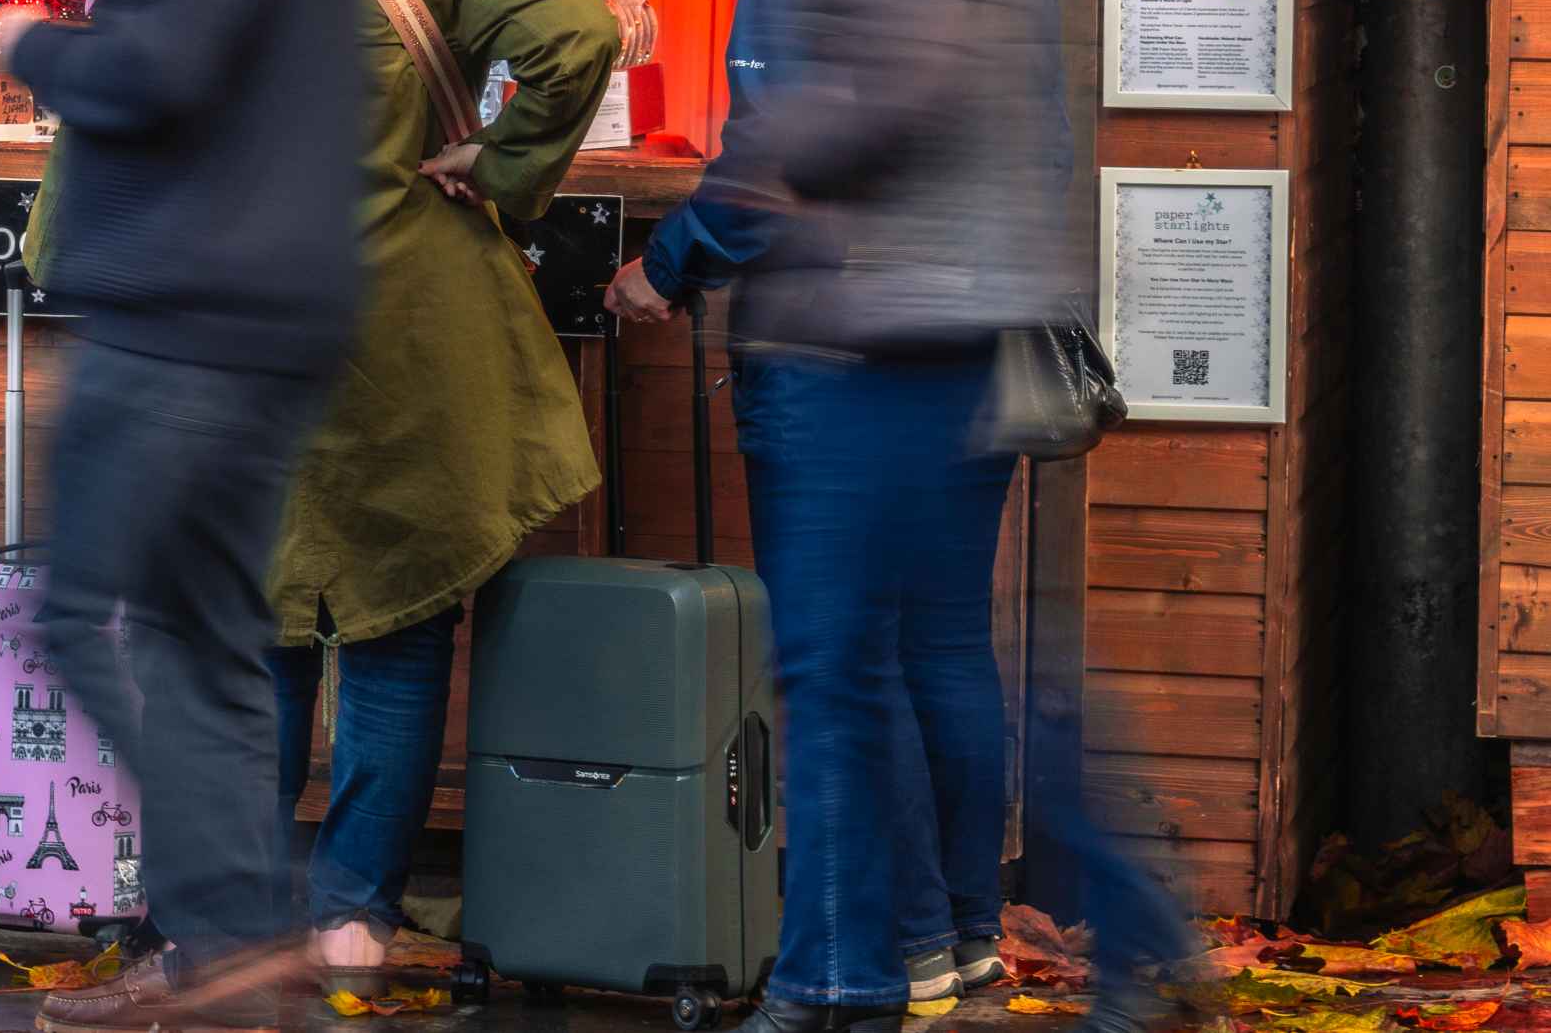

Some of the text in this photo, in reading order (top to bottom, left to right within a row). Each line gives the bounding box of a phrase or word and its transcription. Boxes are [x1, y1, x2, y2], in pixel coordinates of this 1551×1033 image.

[1154, 211, 1194, 222] paper
[1154, 221, 1231, 232] starlights
[575, 770, 611, 780] Samsonite
[65, 776, 102, 797] Paris
